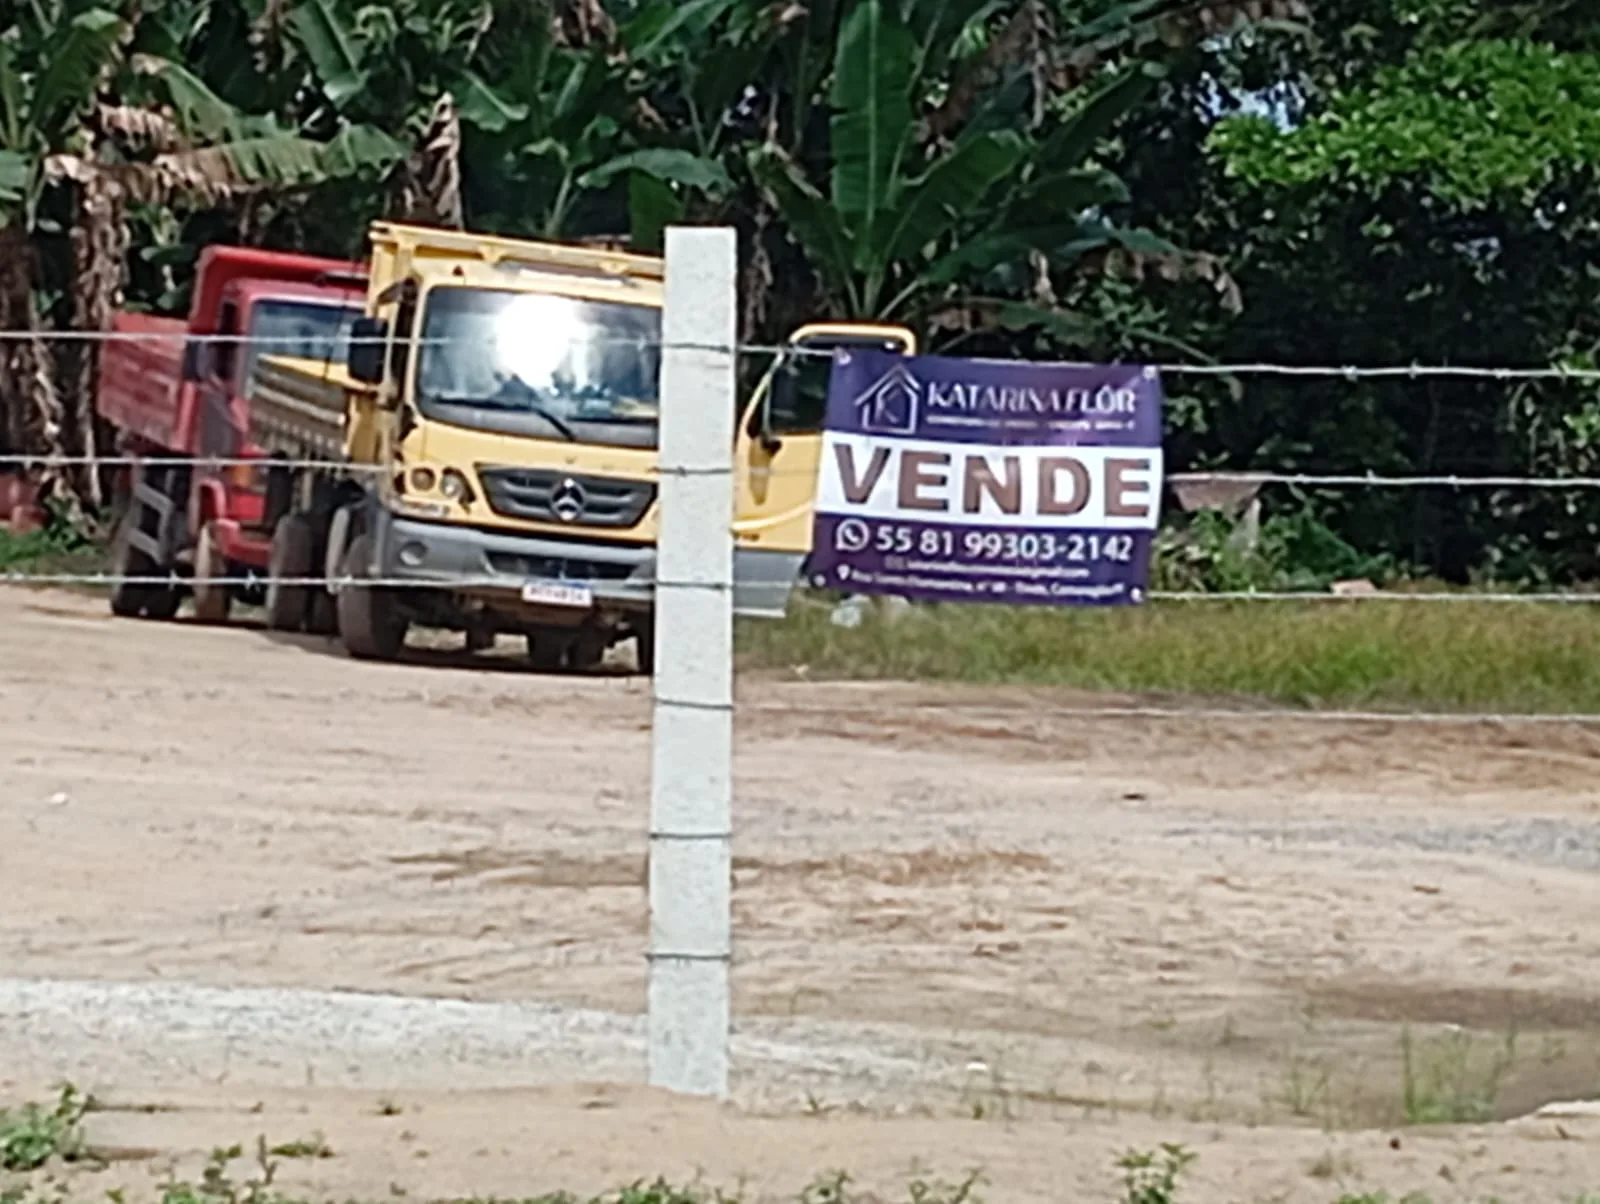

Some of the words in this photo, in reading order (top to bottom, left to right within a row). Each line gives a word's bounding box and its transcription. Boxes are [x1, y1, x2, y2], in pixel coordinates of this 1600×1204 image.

[832, 443, 1152, 517] VENDE
[876, 525, 912, 552] 55
[919, 529, 953, 555] 81
[964, 531, 1133, 561] 99303-2142
